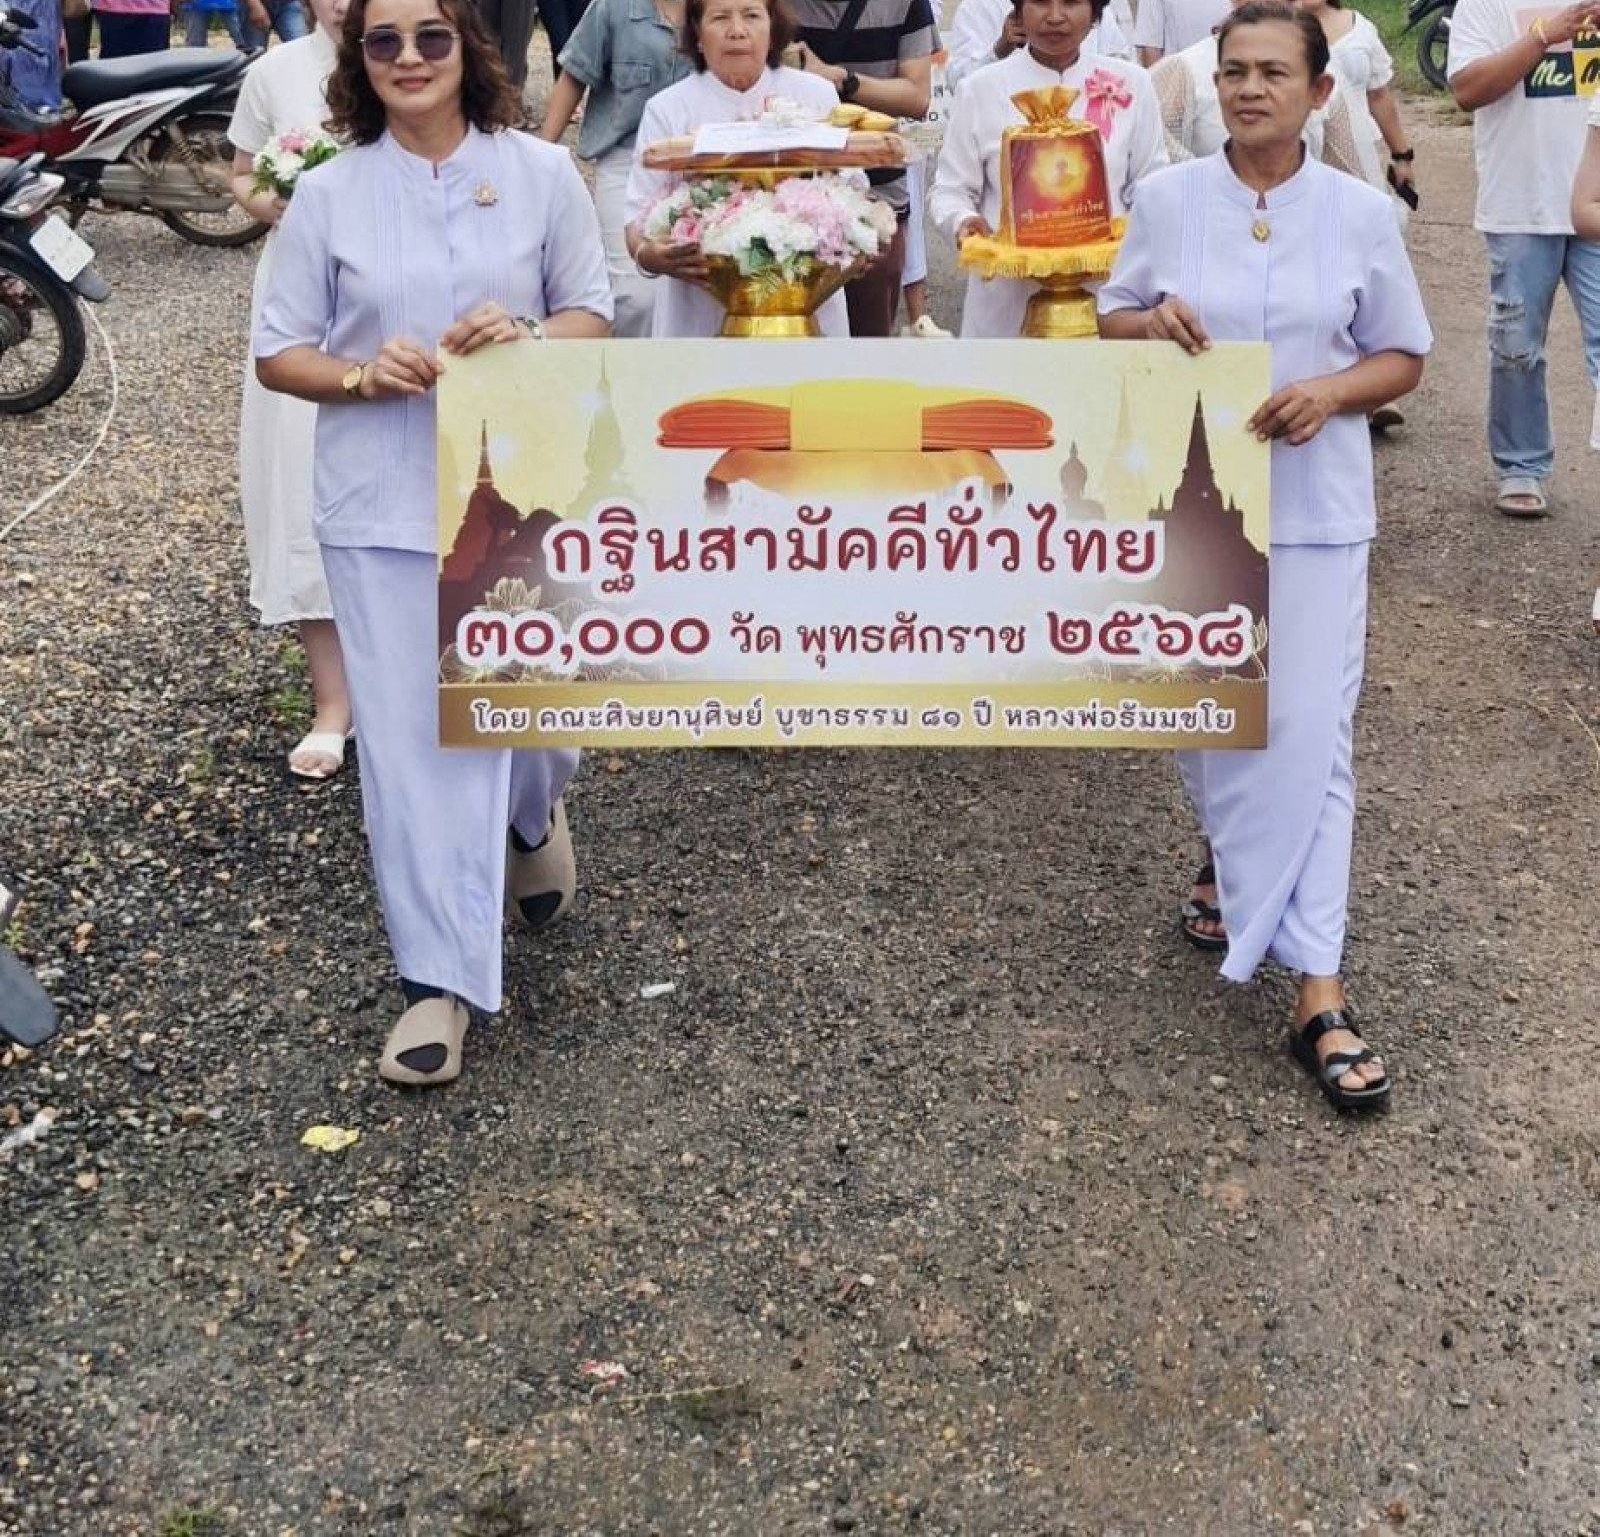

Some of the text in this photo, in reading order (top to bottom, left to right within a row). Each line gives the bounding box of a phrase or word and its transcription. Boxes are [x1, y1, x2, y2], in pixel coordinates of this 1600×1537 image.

[551, 484, 1157, 593] กฐินสามัคคีทั่วไทย
[465, 610, 1243, 669] ๓๐,๐๐๐ วัด พุทธศักราช ๒๕๖๘
[474, 699, 1232, 736] โดย คณะศิษยานุศิษย์ บูชาธรรม ๘๑ ปี หลวงพ่อธัมมชโย
